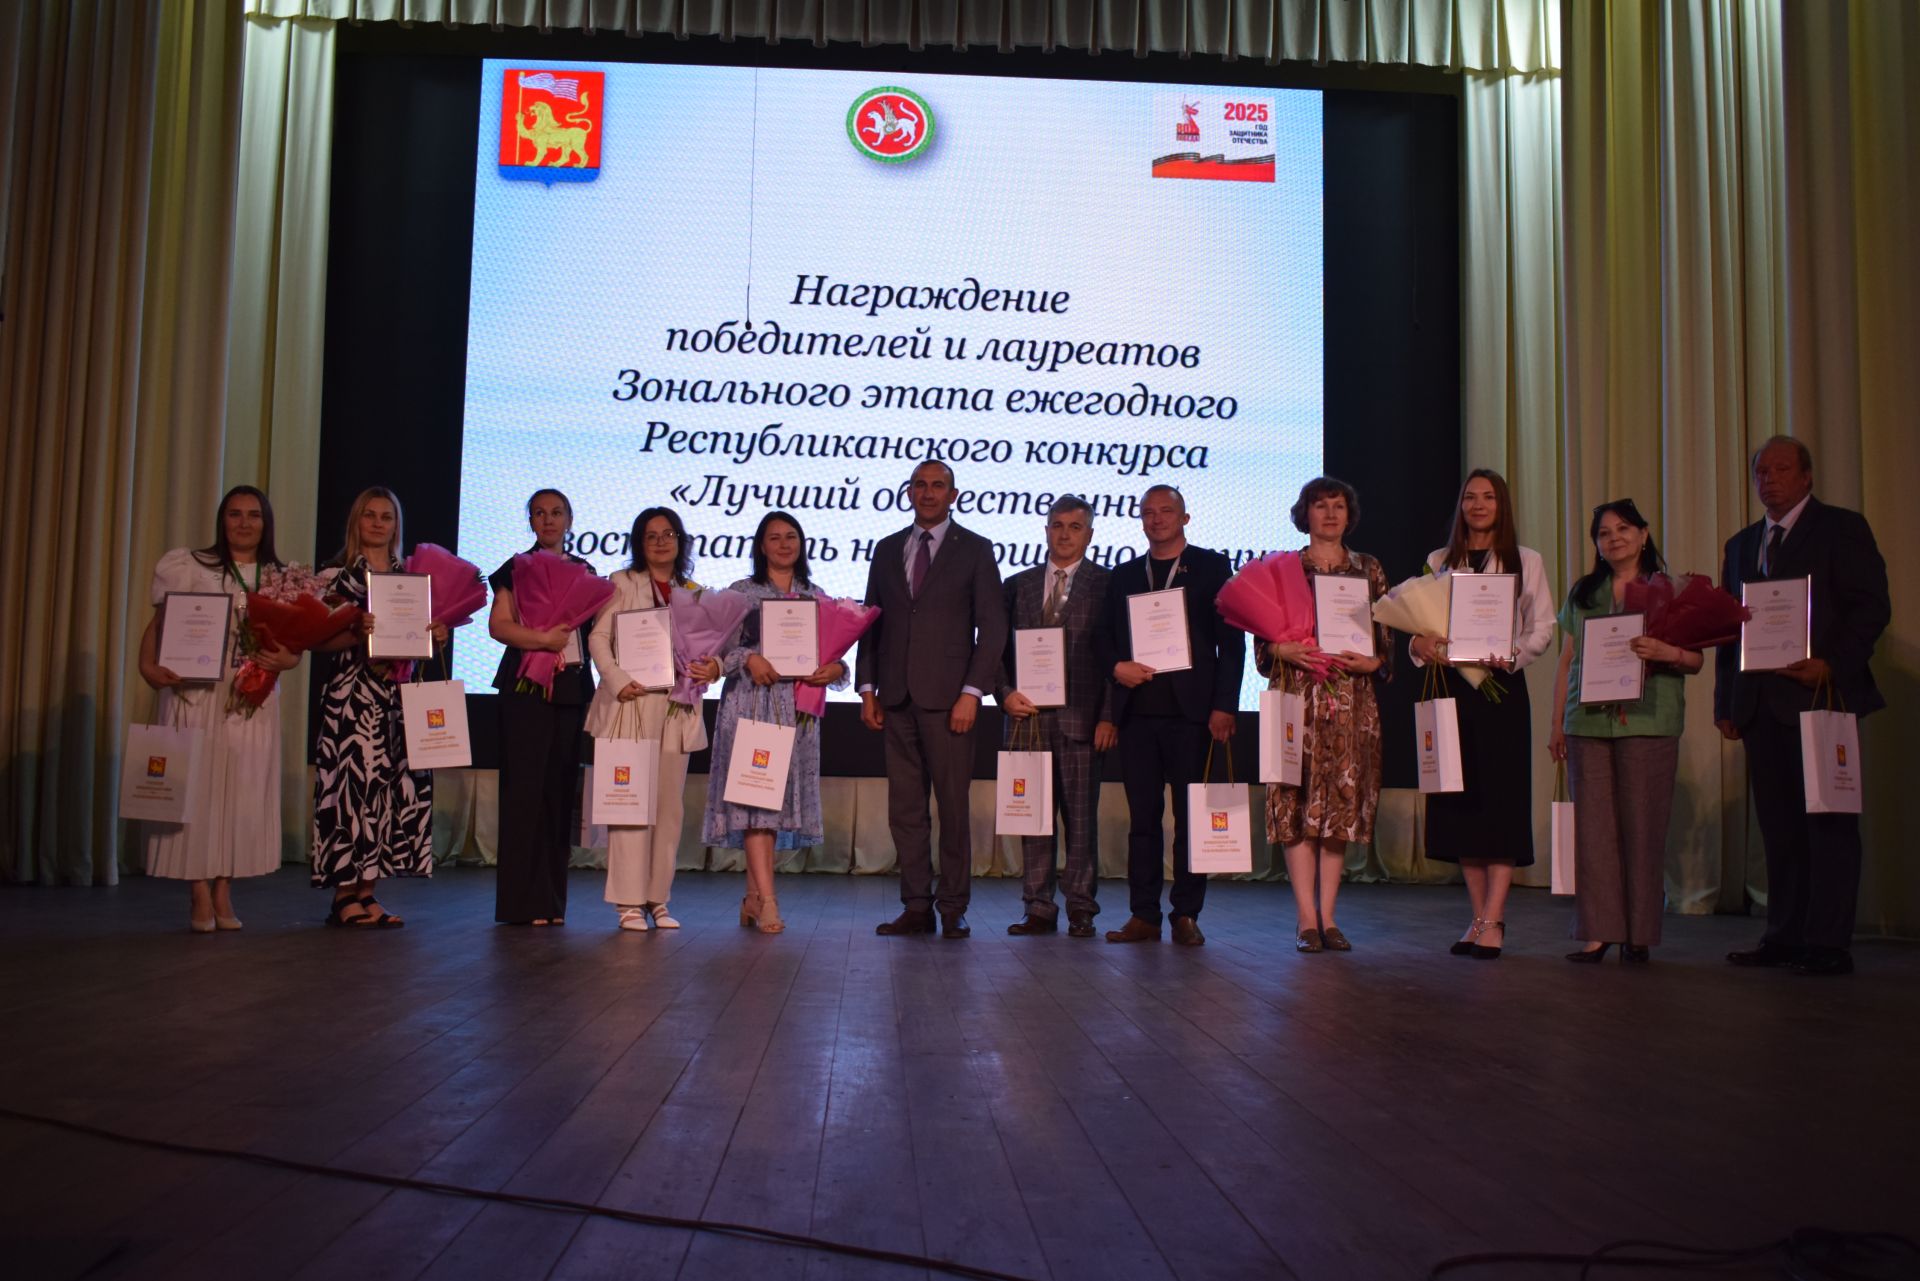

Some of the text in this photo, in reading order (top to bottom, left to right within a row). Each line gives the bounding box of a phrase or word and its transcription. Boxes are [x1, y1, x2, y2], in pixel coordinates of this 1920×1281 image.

[1224, 103, 1268, 123] 2025
[1231, 137, 1268, 145] ОТЕЧЕСТВА
[789, 274, 1070, 317] Награждение
[666, 319, 1201, 373] победителей и лауреатов
[612, 369, 1238, 421] Зонального этапа ежегодного
[639, 421, 1208, 477] Республиканского конкурса
[671, 474, 860, 517] «Лучший
